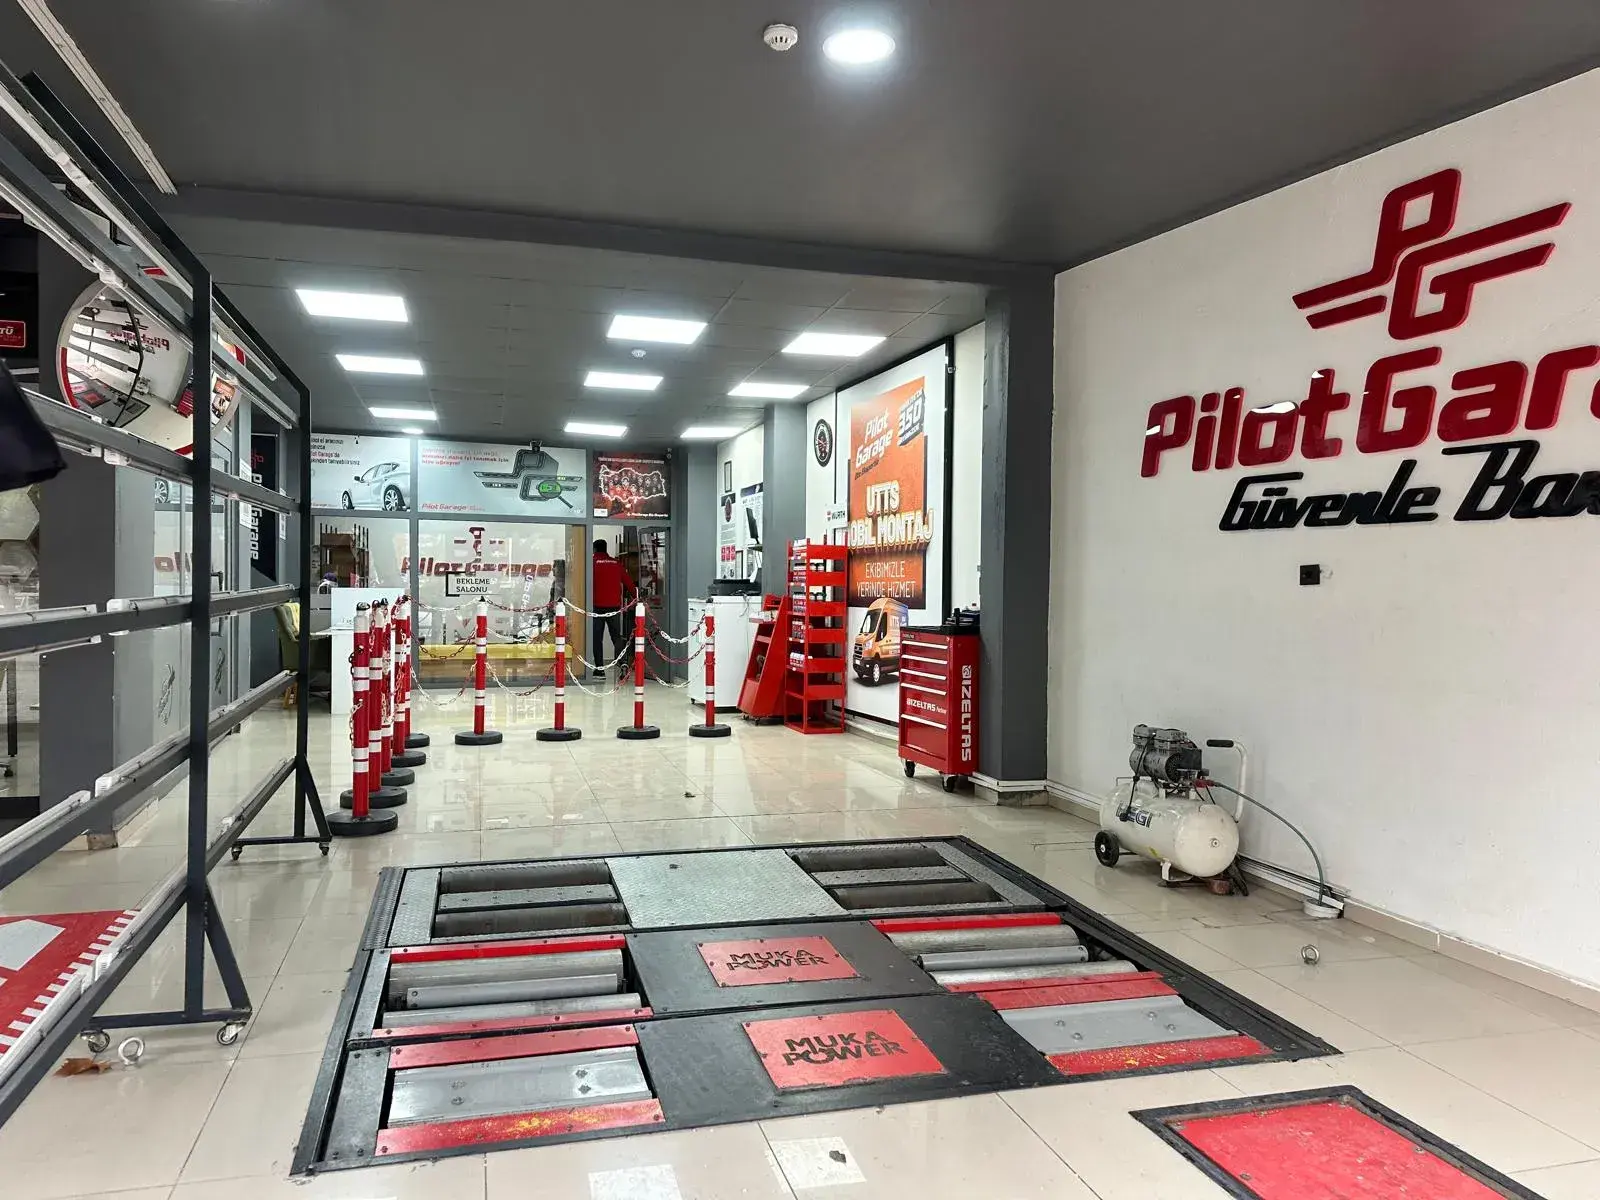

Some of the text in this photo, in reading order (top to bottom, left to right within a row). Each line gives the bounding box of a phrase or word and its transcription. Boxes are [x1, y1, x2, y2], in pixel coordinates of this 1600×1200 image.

[864, 407, 889, 443] Pilot
[1141, 346, 1600, 478] PilotGar
[855, 429, 894, 468] Garage
[866, 480, 900, 515] UTTS
[878, 509, 935, 547] MONTAJ
[856, 581, 916, 598] YERİNDE HİZMET
[727, 956, 829, 971] POWER
[730, 949, 817, 962] MUKA
[782, 1041, 908, 1066] POWER
[784, 1030, 888, 1053] MUKA
